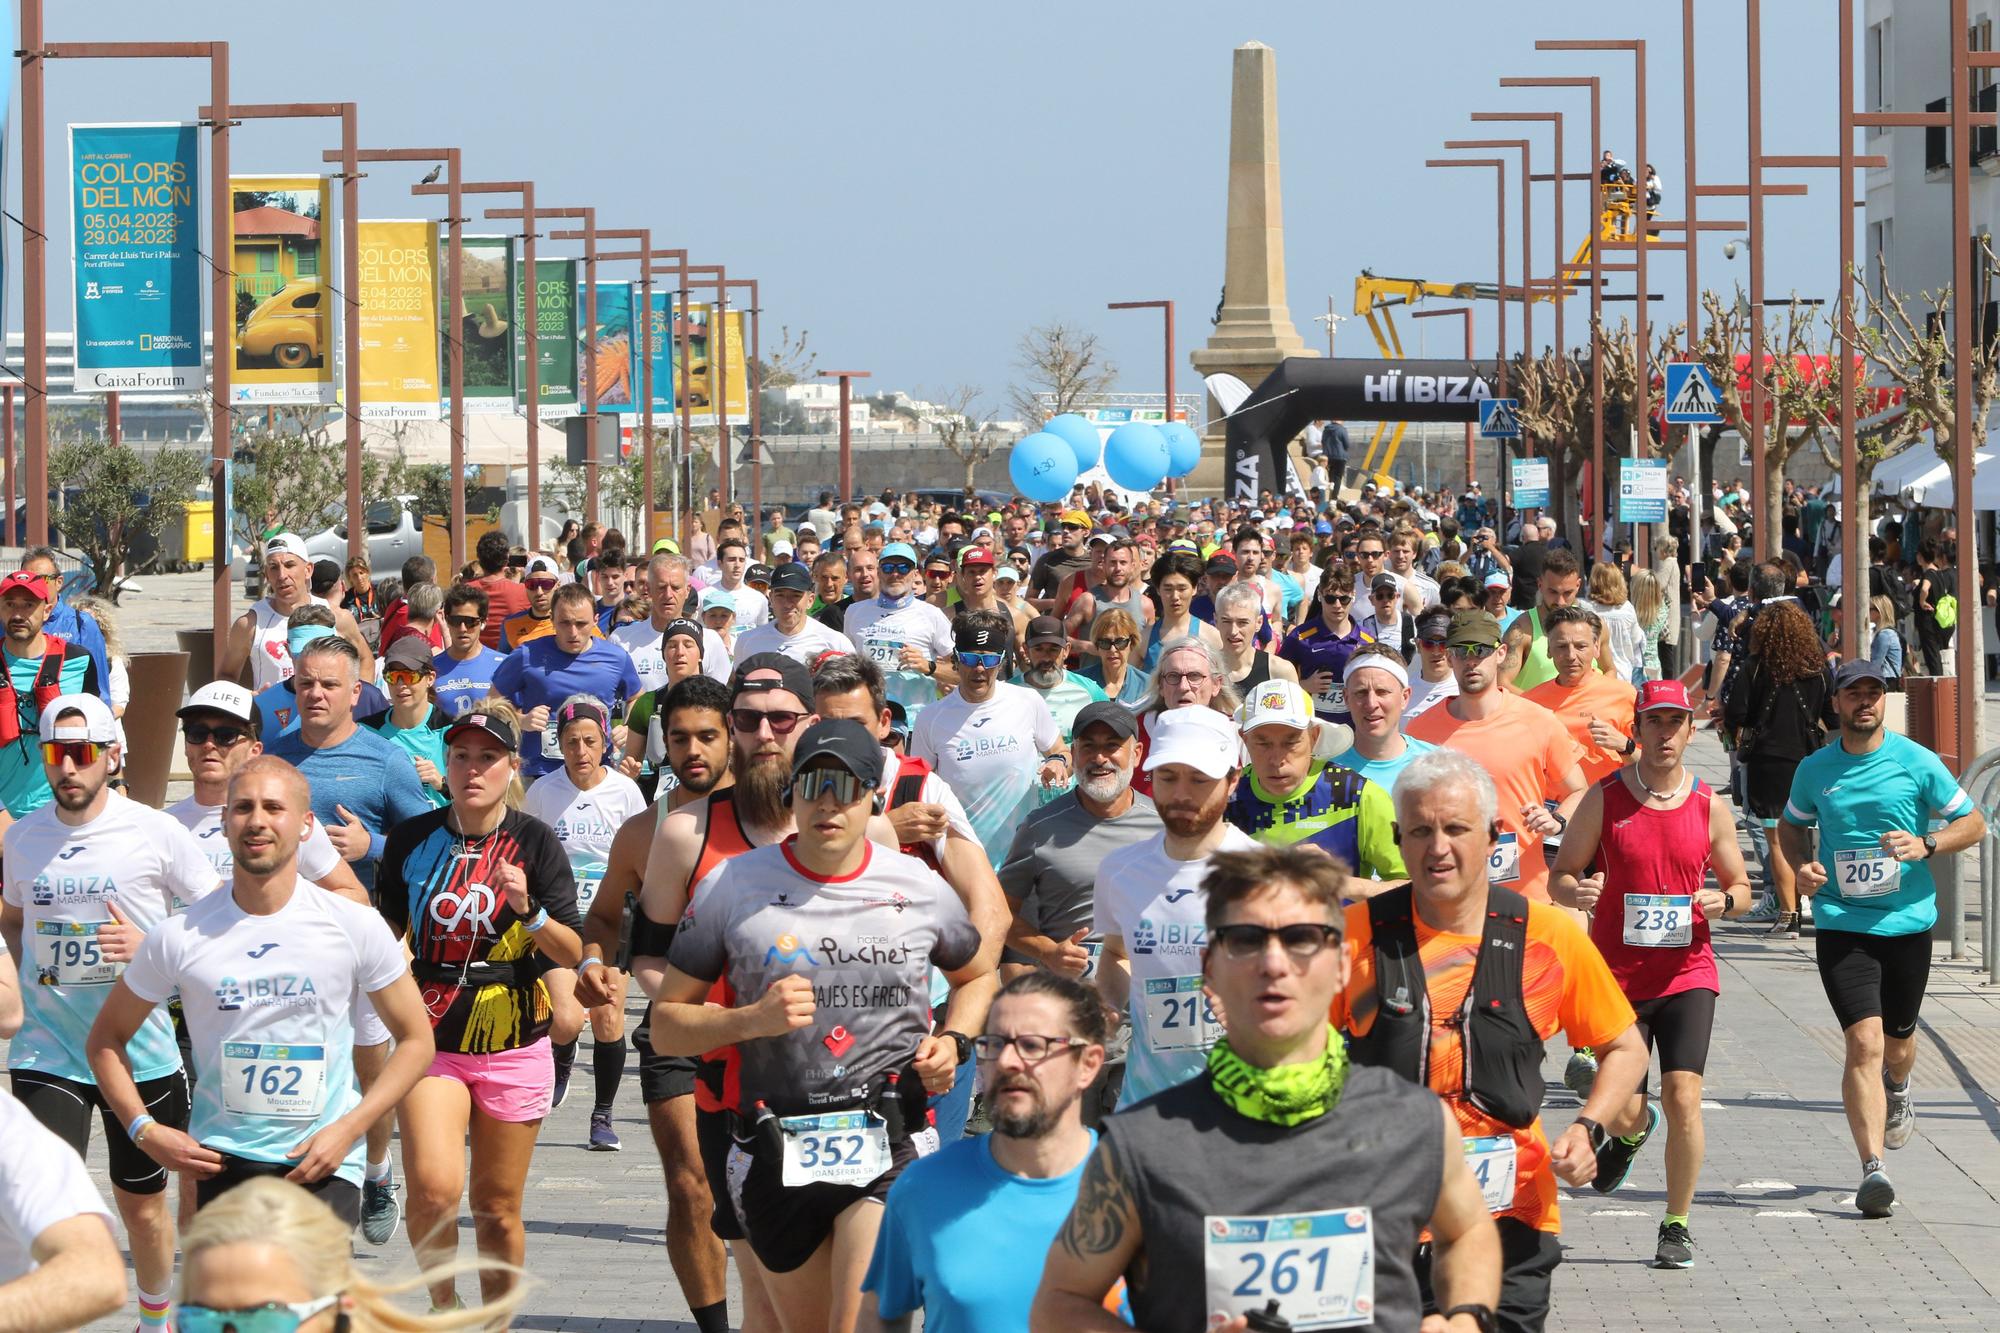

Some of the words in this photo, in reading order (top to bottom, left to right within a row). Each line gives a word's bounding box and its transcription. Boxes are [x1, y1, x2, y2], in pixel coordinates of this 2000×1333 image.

[81, 162, 186, 184] COLORS
[82, 187, 129, 208] DEL
[133, 184, 191, 207] MÓN
[83, 213, 184, 229] 05.04.2023-
[83, 229, 177, 245] 29.04.2023
[84, 252, 108, 260] Carrer
[359, 299, 422, 310] 9.04.2023
[95, 373, 185, 387] CaixaForum
[254, 387, 290, 397] Fundació
[1404, 375, 1492, 403] IBIZA
[870, 648, 893, 661] 291
[212, 692, 241, 706] LIFE
[453, 695, 472, 714] 10
[976, 736, 1018, 751] IBIZA
[976, 745, 1020, 759] MARATHON
[571, 822, 612, 837] IBIZA
[1490, 848, 1503, 868] 6
[1845, 862, 1883, 883] 205
[57, 876, 118, 895] IBIZA
[57, 894, 119, 905] MARATHON
[1634, 910, 1678, 931] 238
[858, 936, 888, 944] hotel
[1161, 924, 1208, 945] IBIZ
[50, 940, 100, 967] 195
[819, 937, 912, 966] Puchet
[1161, 945, 1197, 956] MARAT
[247, 977, 316, 997] IBIZA
[249, 996, 317, 1008] MARATHON
[853, 985, 869, 1007] ES
[872, 985, 911, 1007] FREUS
[1162, 997, 1217, 1028] 218
[241, 1065, 303, 1096] 162
[267, 1097, 312, 1106] Moustache
[800, 1135, 864, 1168] 352
[1232, 1247, 1330, 1297] 261
[1319, 1295, 1349, 1307] Cliffy
